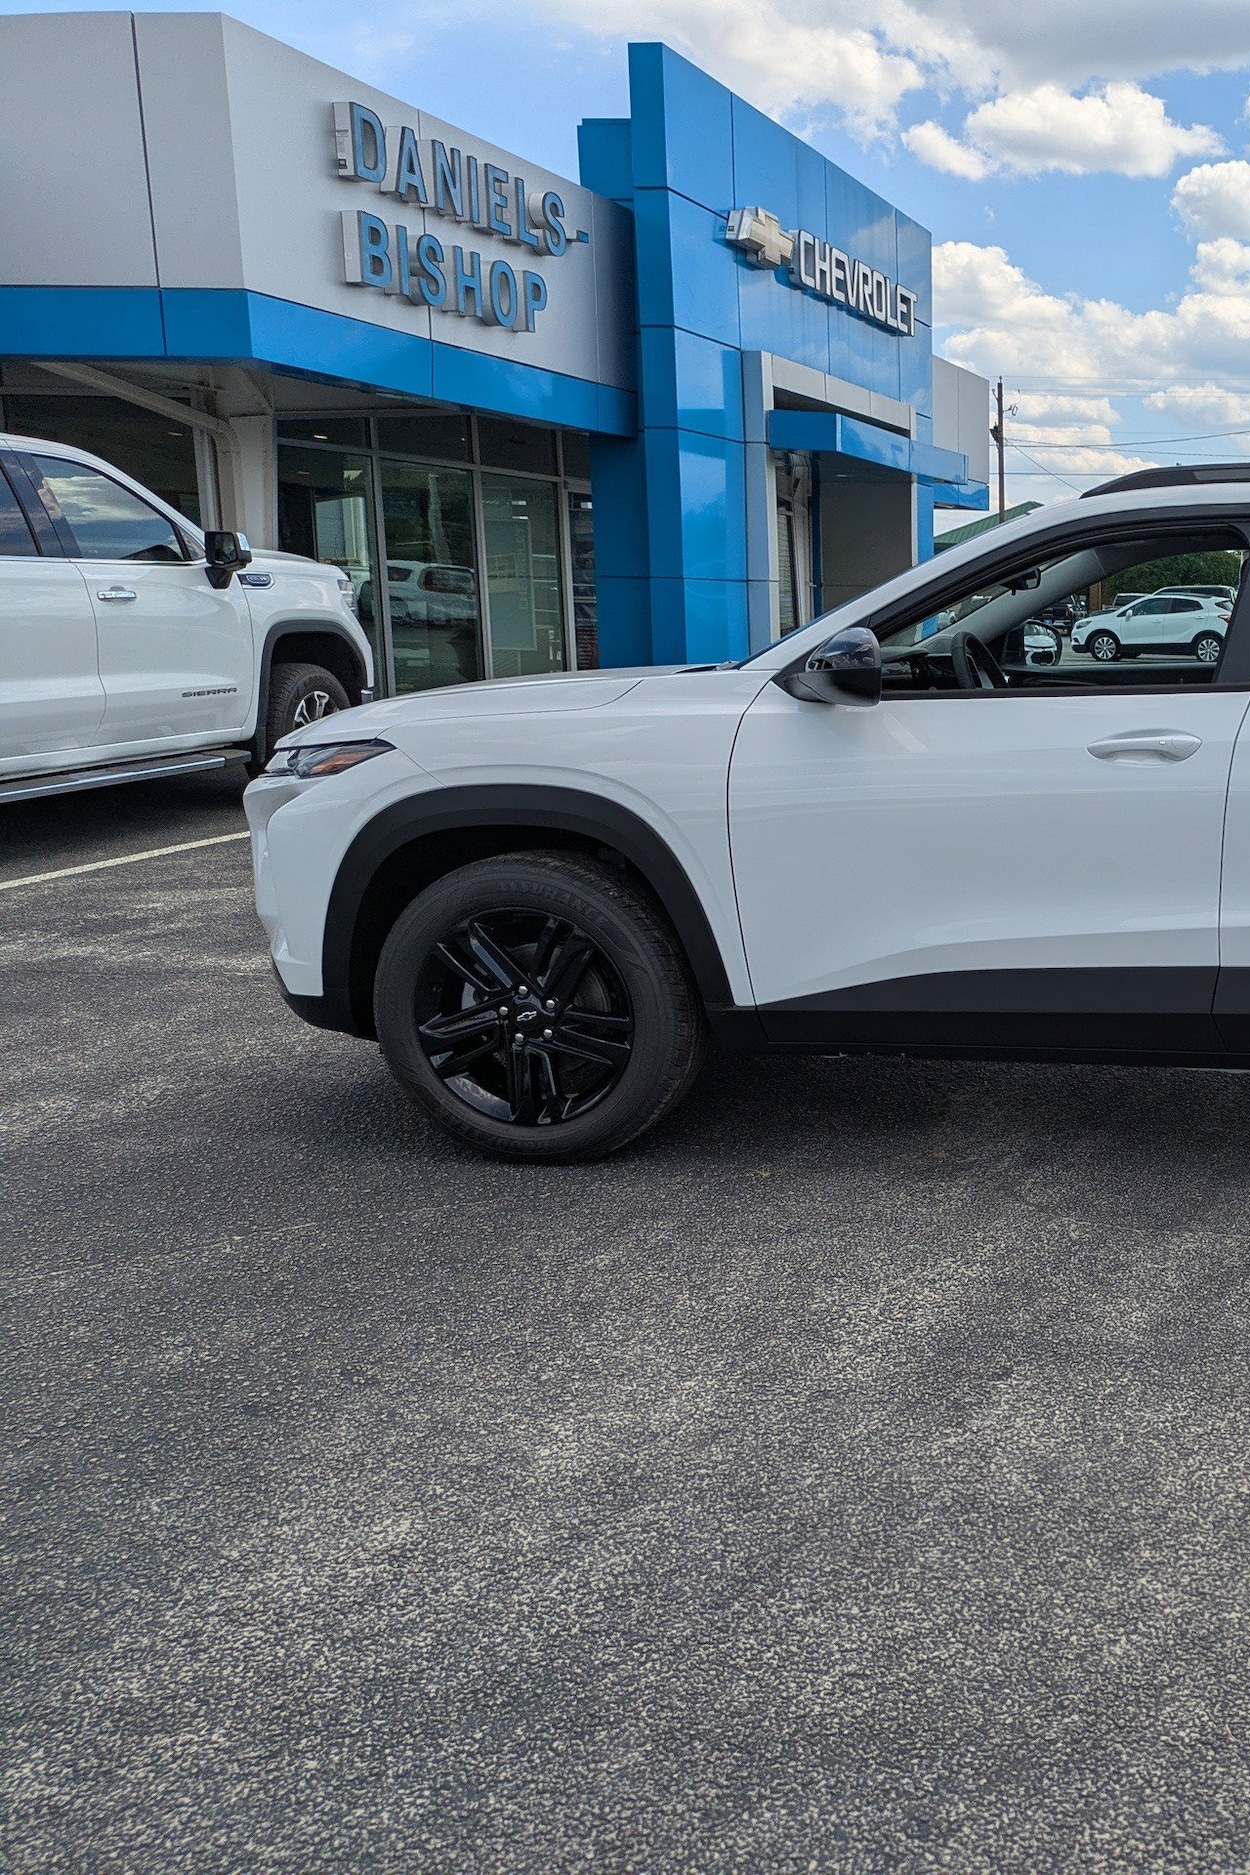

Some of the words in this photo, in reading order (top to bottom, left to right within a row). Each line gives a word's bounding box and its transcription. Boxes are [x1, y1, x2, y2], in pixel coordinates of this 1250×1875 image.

[348, 101, 590, 258] DANIELS-
[356, 209, 548, 333] BISHOP
[798, 229, 918, 337] CHEVROLET
[181, 687, 238, 698] SIERRA
